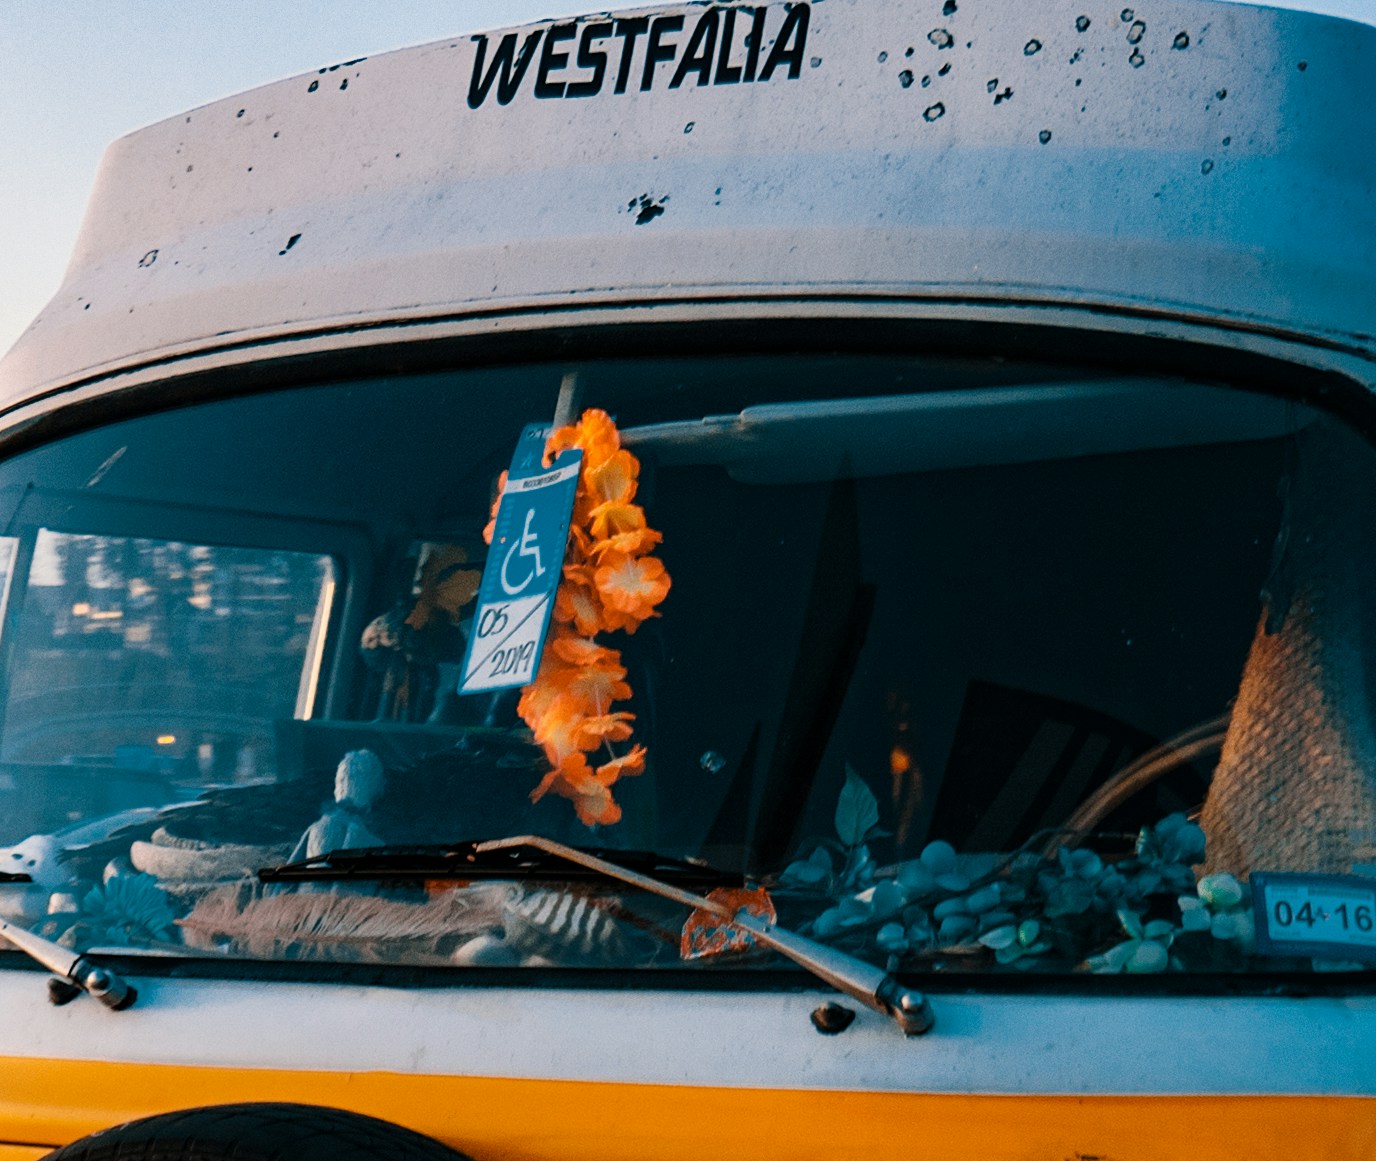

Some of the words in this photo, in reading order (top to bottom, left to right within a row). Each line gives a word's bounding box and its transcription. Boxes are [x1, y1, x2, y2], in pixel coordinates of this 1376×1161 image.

[467, 3, 811, 109] WESTFALIA
[477, 604, 510, 638] 05
[489, 641, 535, 678] 2019
[1275, 901, 1316, 928] 04
[1334, 903, 1373, 932] 16
